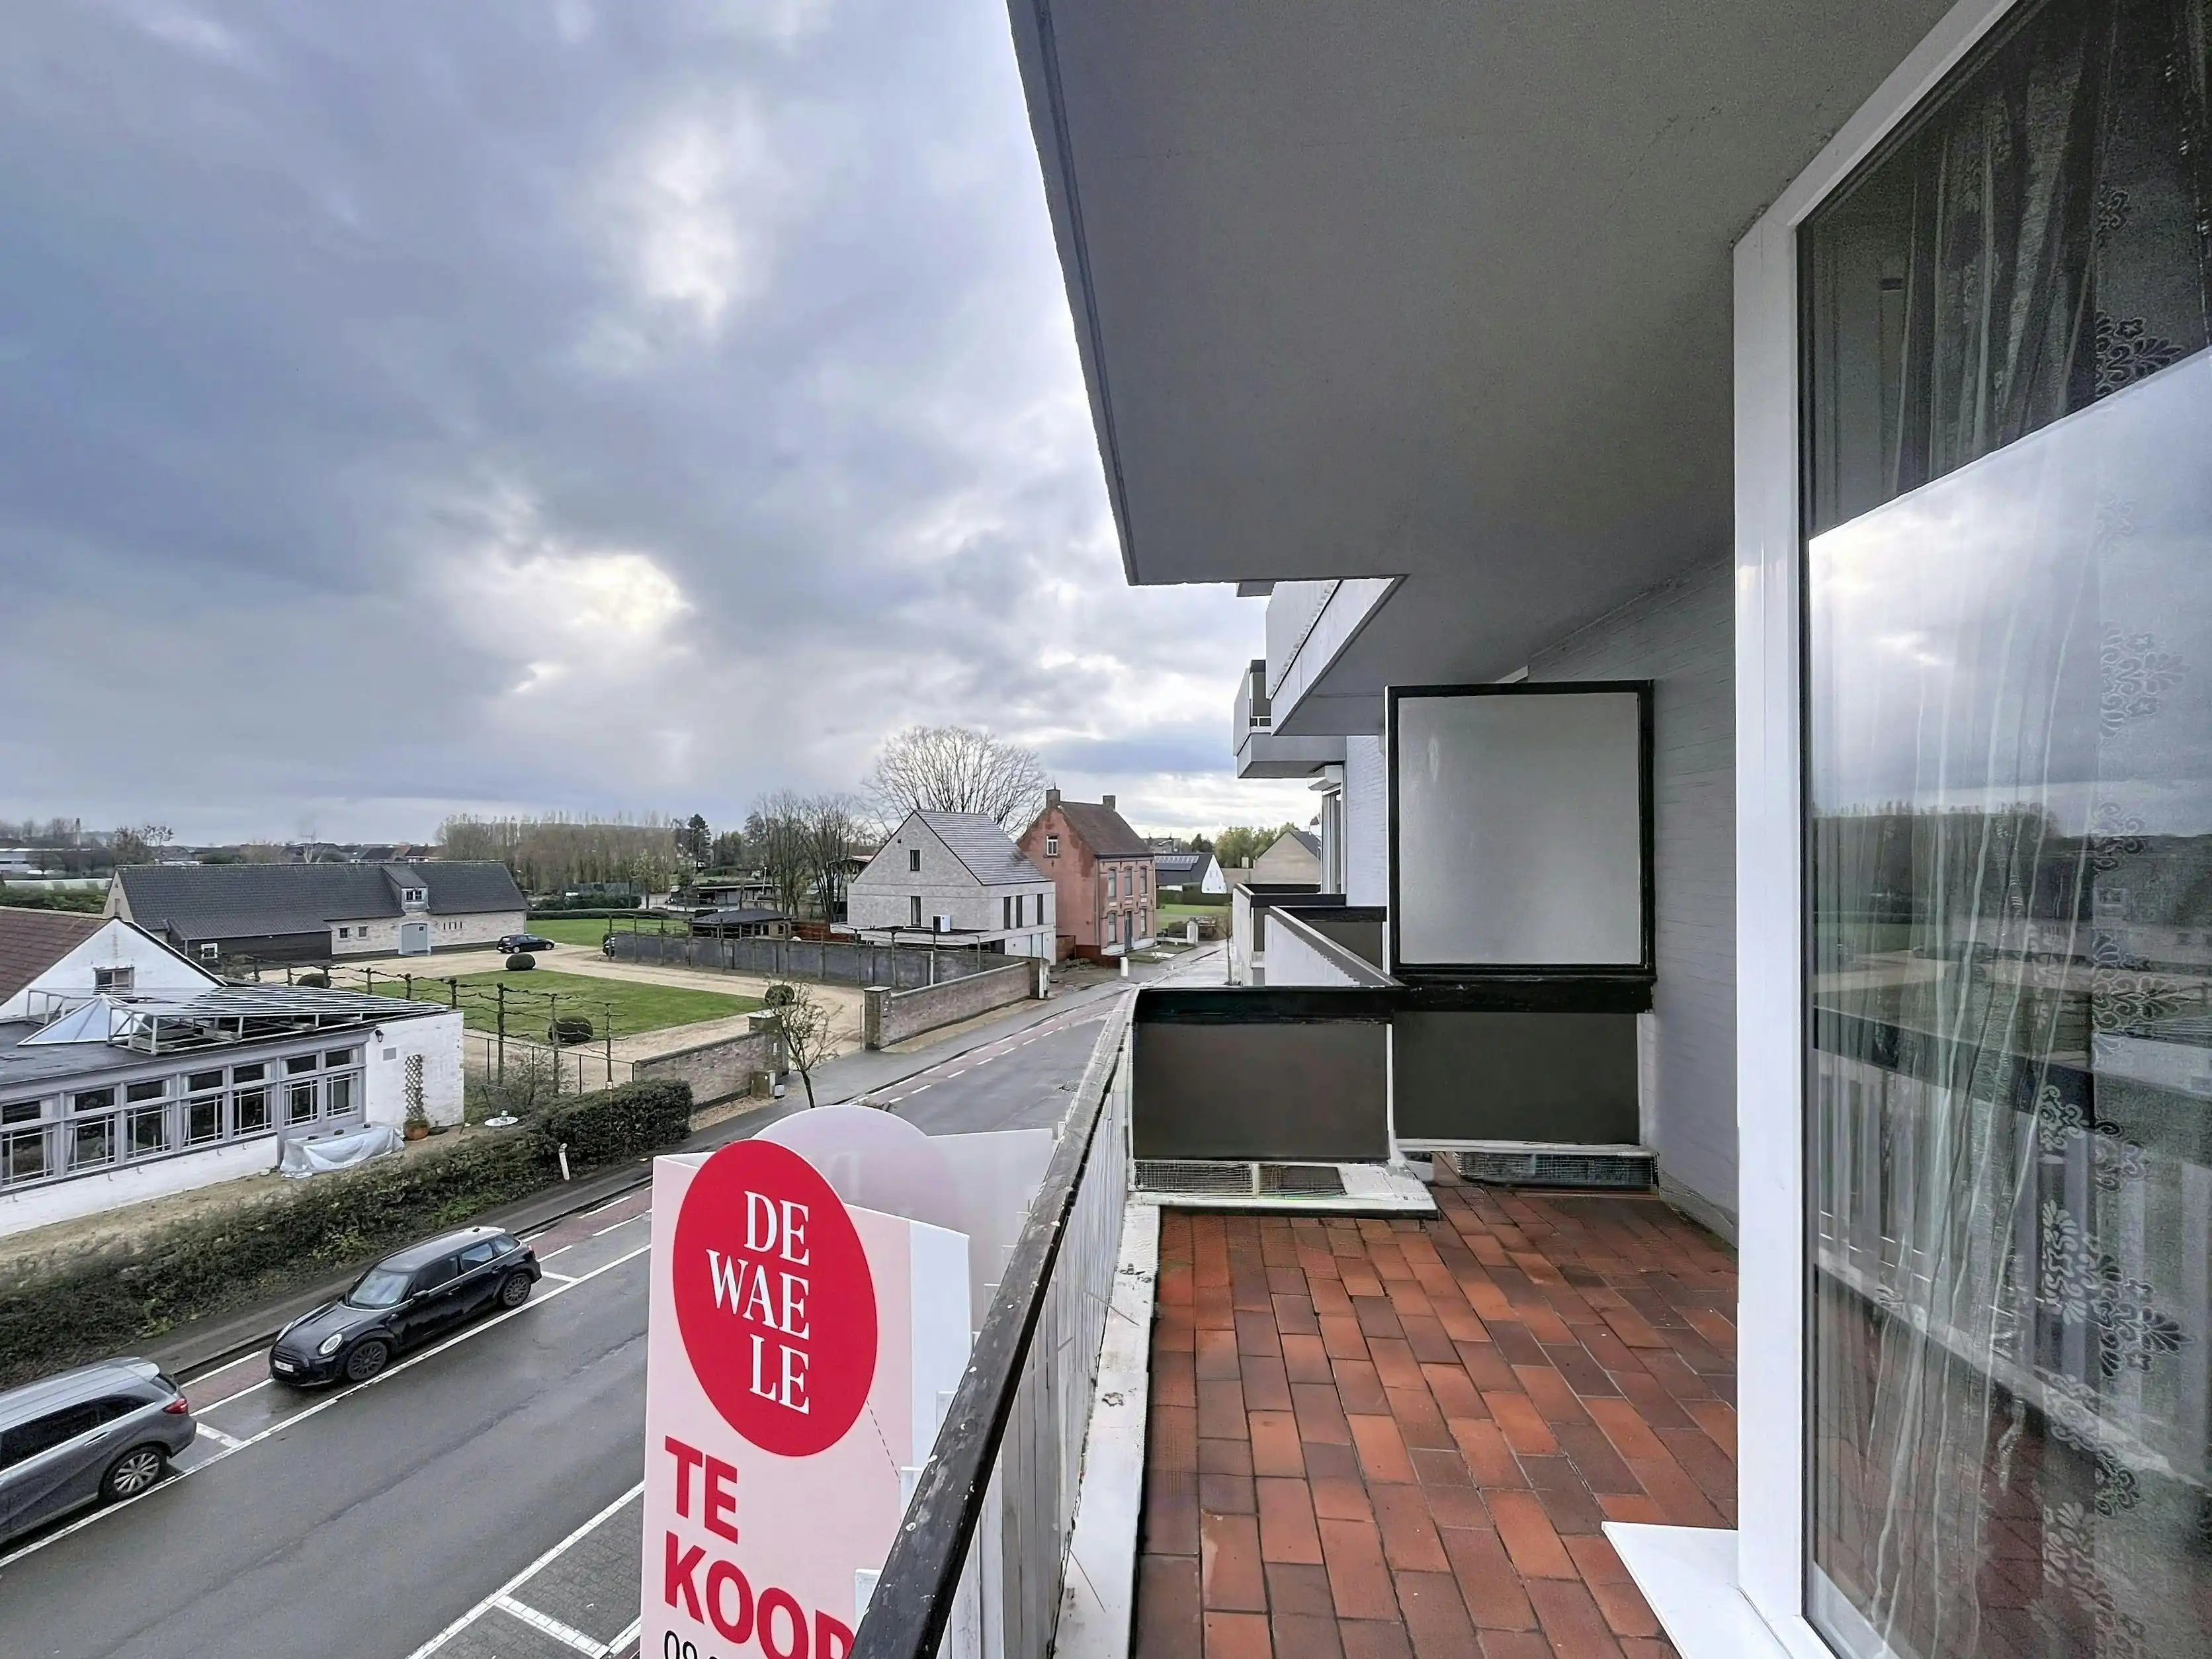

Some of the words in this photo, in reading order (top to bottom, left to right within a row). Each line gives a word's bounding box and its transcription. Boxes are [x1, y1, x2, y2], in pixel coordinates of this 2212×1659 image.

[744, 1191, 809, 1266] DE
[706, 1249, 810, 1340] WAE
[749, 1334, 809, 1415] LE
[664, 1435, 739, 1544] TE
